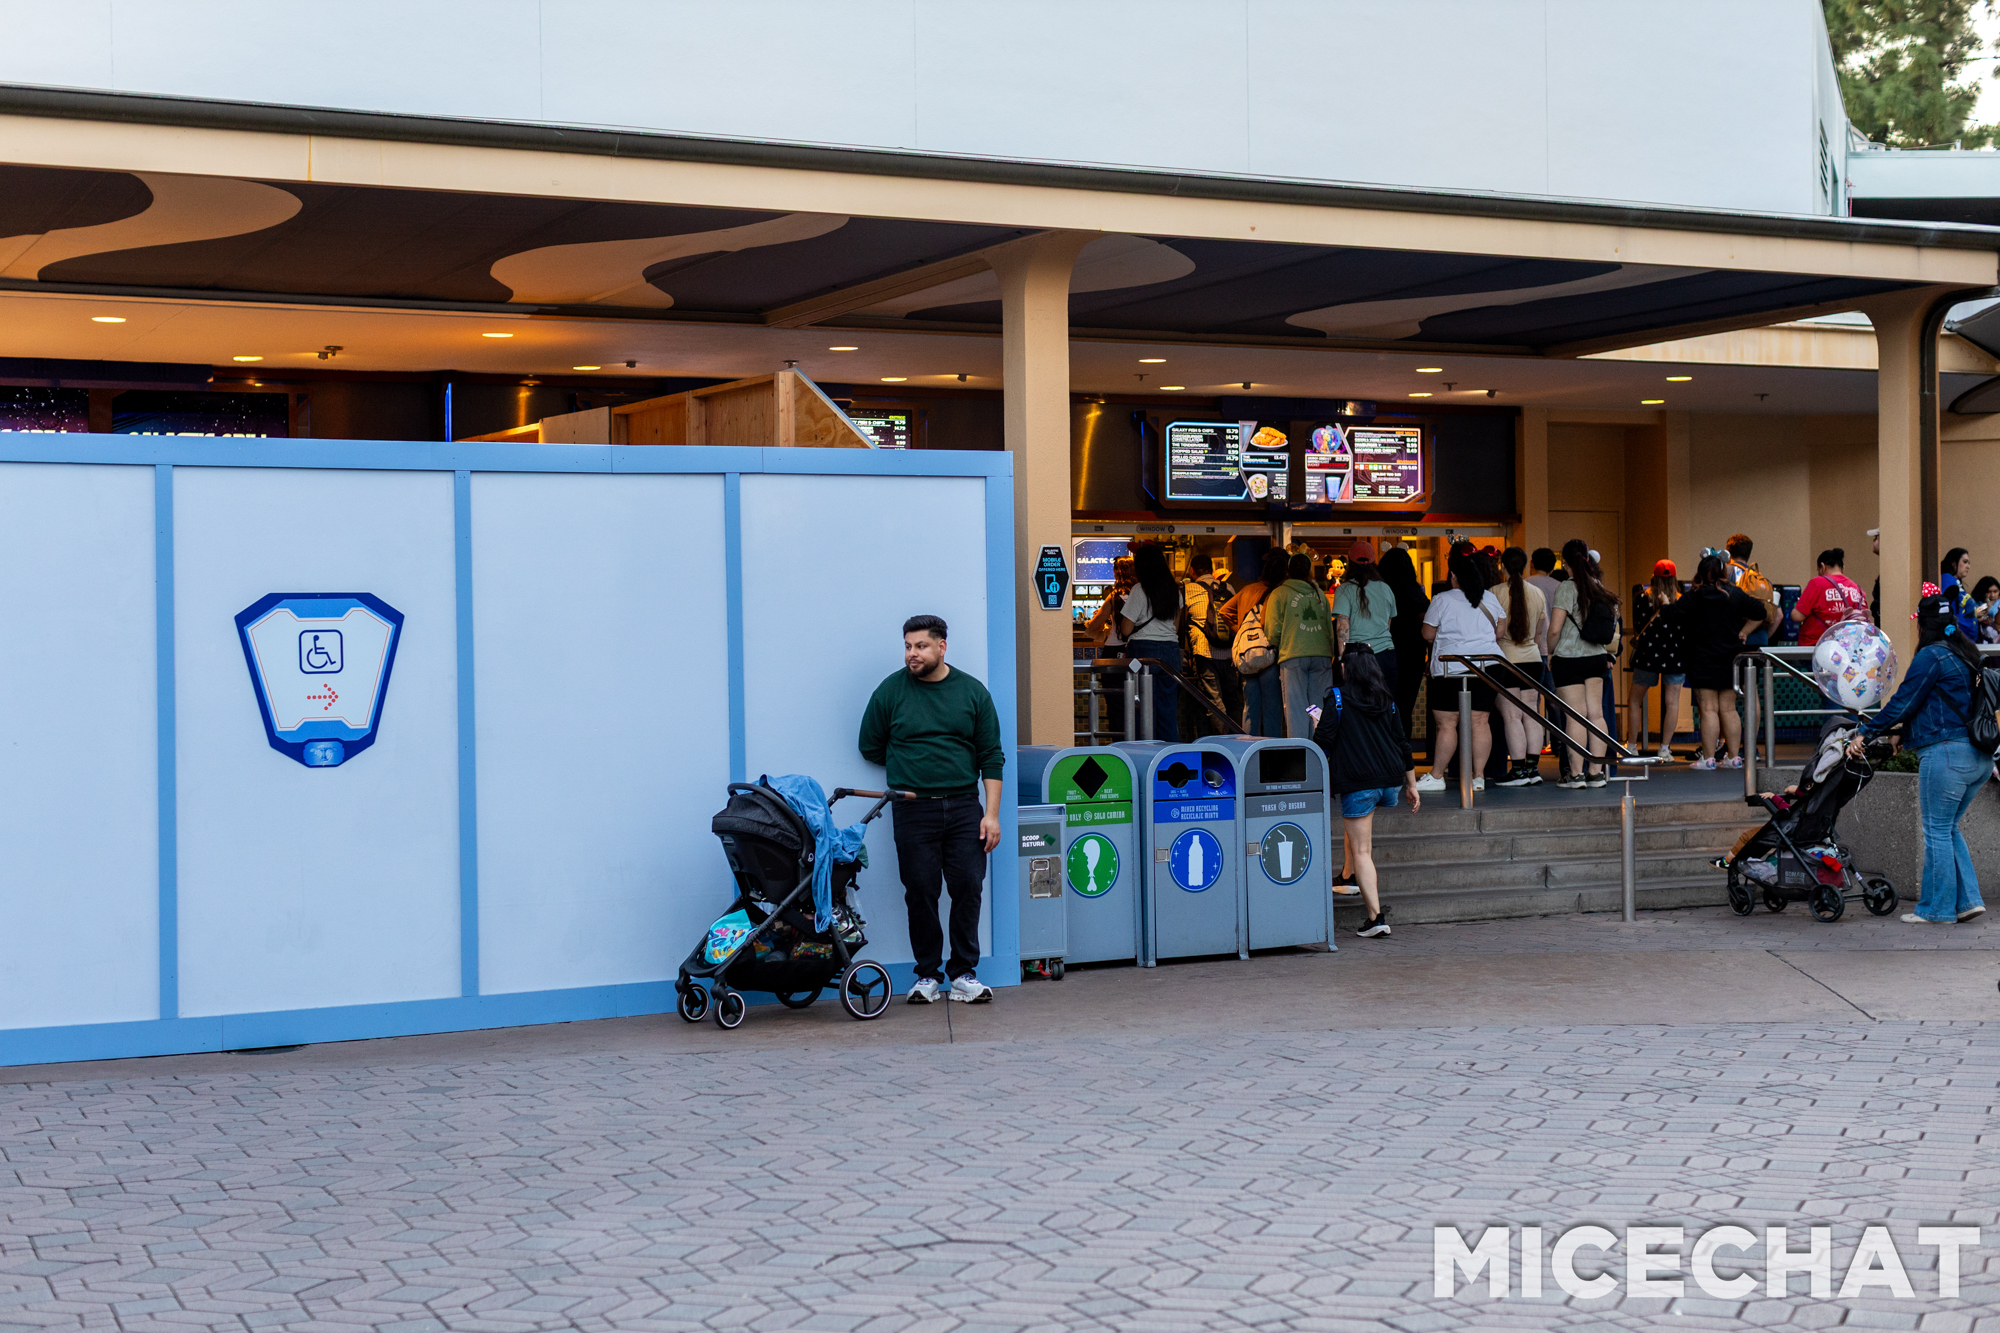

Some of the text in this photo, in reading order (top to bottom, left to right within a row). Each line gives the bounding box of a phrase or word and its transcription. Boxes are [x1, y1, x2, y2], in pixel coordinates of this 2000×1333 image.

[1262, 802, 1307, 812] TRASH BASURA
[1070, 814, 1082, 822] ONLY
[1107, 810, 1125, 819] COMIDA
